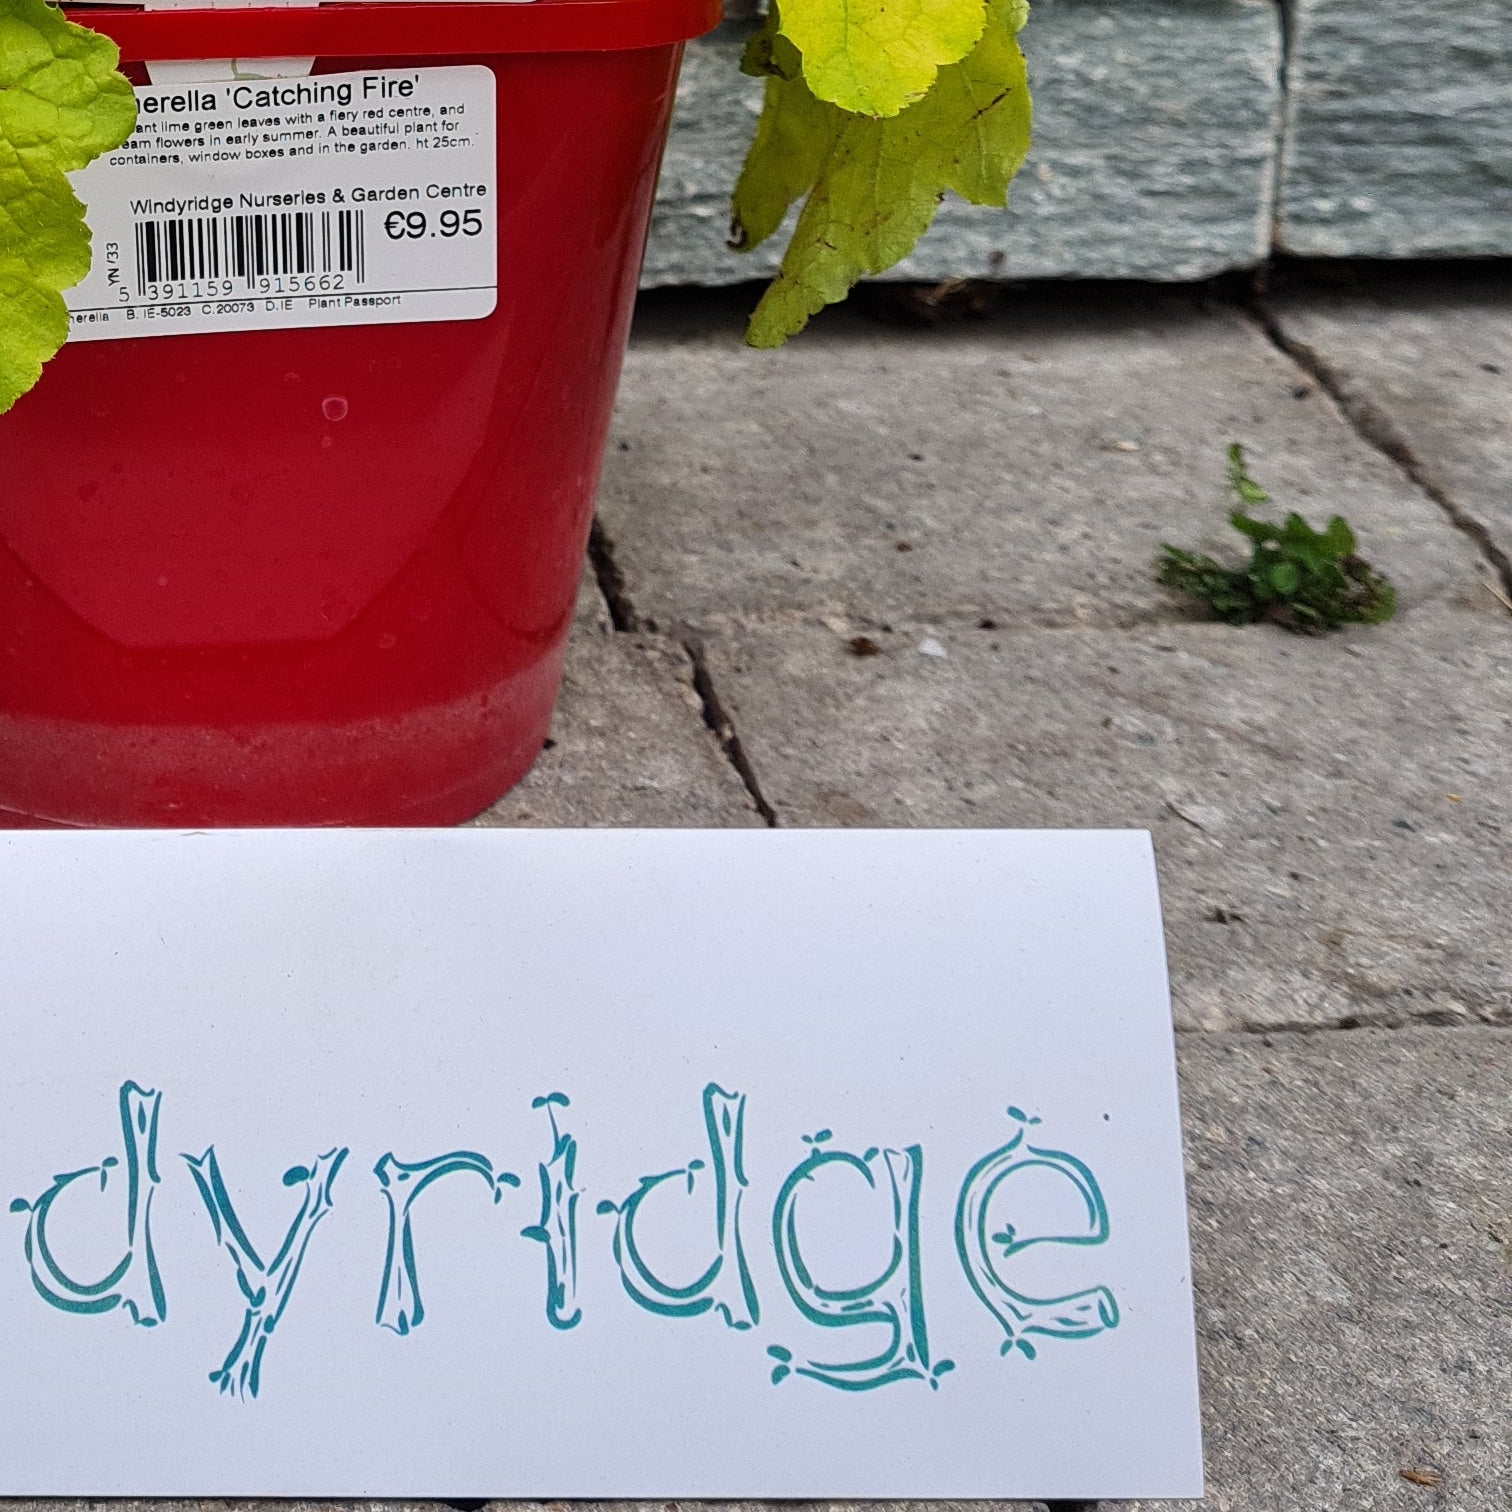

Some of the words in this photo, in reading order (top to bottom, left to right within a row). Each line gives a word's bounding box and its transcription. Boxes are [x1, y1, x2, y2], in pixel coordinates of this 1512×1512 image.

[226, 81, 352, 110] 'Catching
[363, 74, 419, 100] Fire'
[135, 121, 158, 134] ant
[161, 119, 190, 133] lime
[194, 119, 233, 134] green
[238, 116, 281, 130] leaves
[285, 112, 313, 125] with
[317, 111, 325, 123] a
[329, 109, 359, 123] fiery
[363, 107, 384, 120] red
[388, 105, 435, 119] centre,
[439, 103, 465, 116] and
[121, 139, 152, 150] eam
[155, 136, 205, 149] flowers
[209, 134, 222, 146] in
[226, 132, 259, 147] early
[262, 129, 322, 143] summer.
[327, 125, 337, 138] A
[341, 121, 400, 137] beautiful
[404, 120, 438, 136] plant
[441, 119, 460, 132] for
[109, 150, 184, 167] containers,
[188, 149, 241, 164] window
[245, 147, 285, 161] boxes
[289, 144, 314, 157] and
[318, 141, 330, 155] in
[334, 140, 356, 154] the
[359, 139, 411, 155] garden.
[416, 137, 429, 150] ht
[432, 135, 475, 149] 25cm.
[130, 195, 234, 216] Windyridge
[239, 189, 326, 209] Nurseries
[332, 188, 346, 204] &
[351, 185, 421, 203] Garden
[425, 183, 488, 199] Centre
[383, 208, 484, 240] €9.95
[107, 268, 121, 287] YN
[118, 286, 130, 303] 5
[148, 280, 234, 301] 391159
[259, 273, 345, 294] 915662
[126, 308, 139, 321] B.
[143, 306, 192, 320] IE-5023
[201, 301, 256, 316] C.20073
[265, 299, 294, 312] D.IE
[308, 297, 341, 310] Plant
[344, 294, 401, 310] Passport
